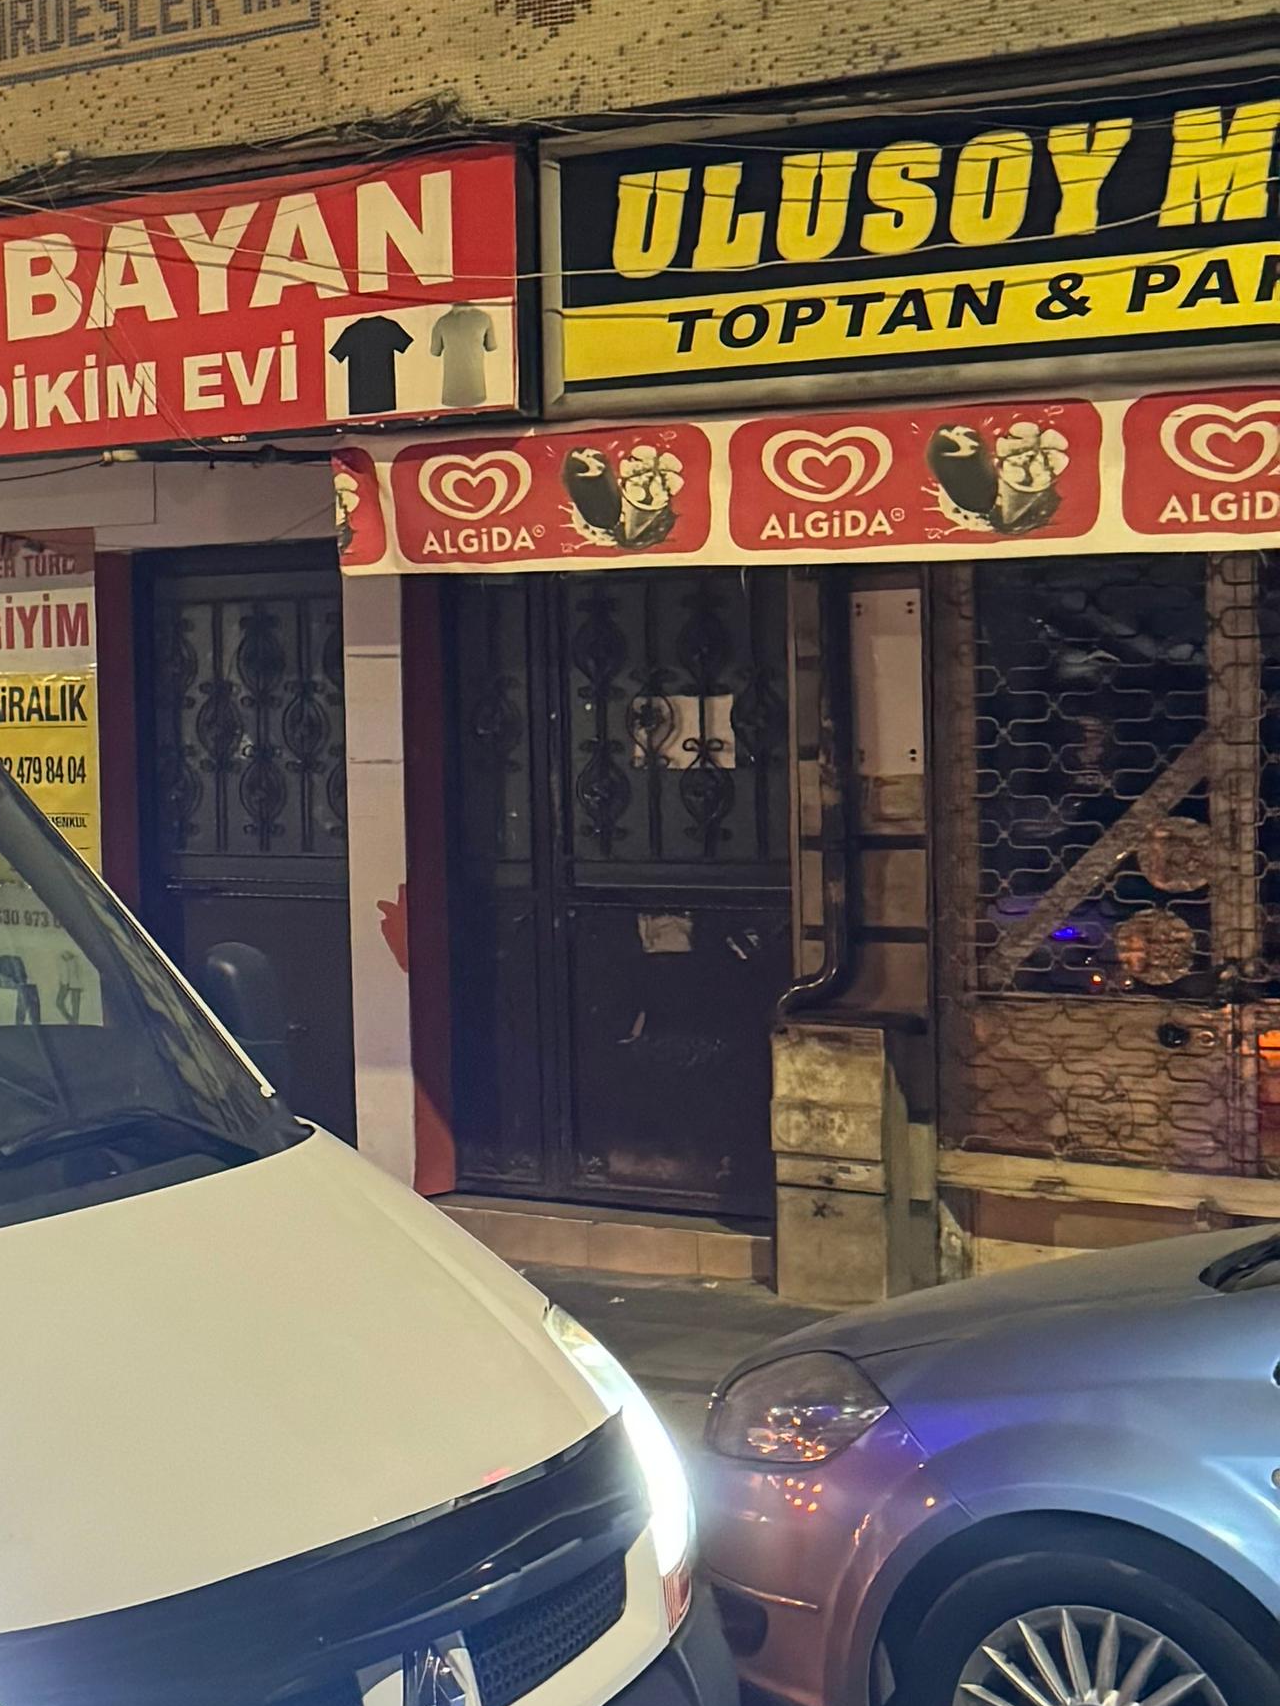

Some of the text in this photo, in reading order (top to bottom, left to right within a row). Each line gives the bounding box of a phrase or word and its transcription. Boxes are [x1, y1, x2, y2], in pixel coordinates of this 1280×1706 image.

[612, 117, 1134, 279] ULUSOY
[3, 172, 455, 343] BAYAN
[667, 279, 1006, 354] TOPTAN
[1035, 273, 1092, 318] &
[182, 329, 299, 411] EVİ
[17, 756, 42, 784] 479
[46, 756, 64, 783] 84
[68, 756, 87, 783] 04
